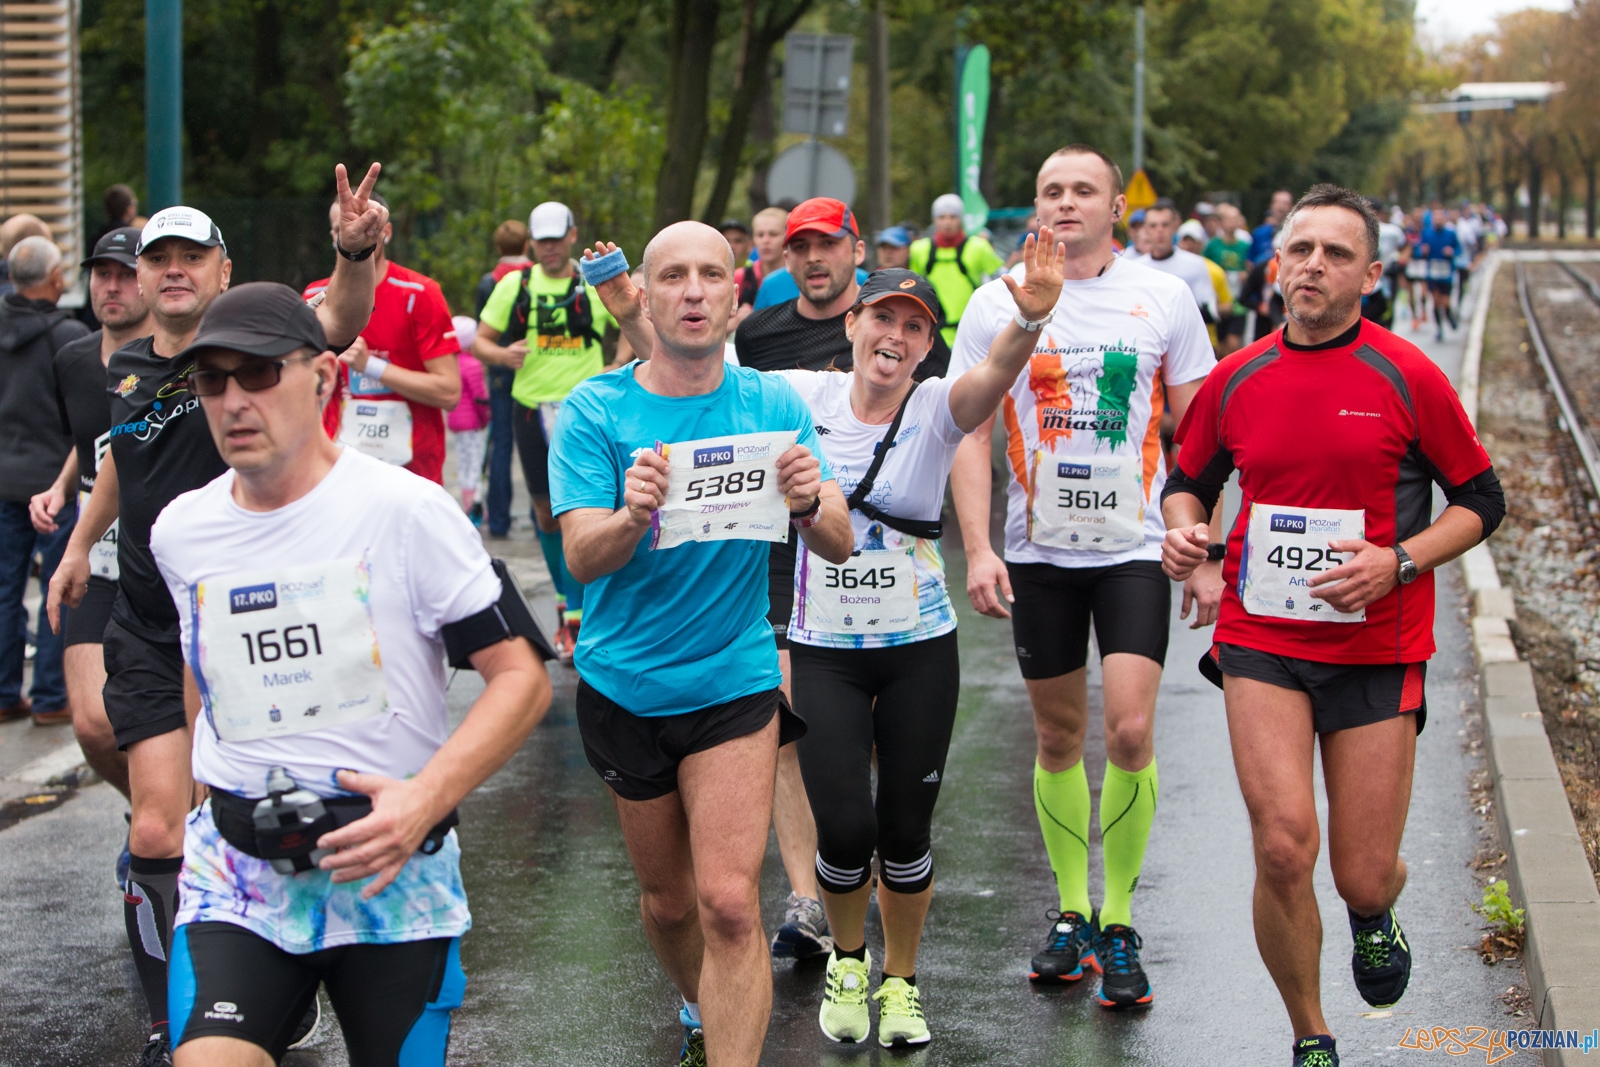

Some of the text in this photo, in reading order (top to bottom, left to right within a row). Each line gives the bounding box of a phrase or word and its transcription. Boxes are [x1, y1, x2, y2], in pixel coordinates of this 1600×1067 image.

[1099, 344, 1137, 353] Kasta
[1042, 415, 1125, 431] Miasta
[357, 423, 389, 438] 788
[737, 451, 770, 461] maraton
[685, 469, 766, 501] 5389
[1058, 488, 1118, 509] 3614
[700, 501, 751, 514] Zbigniew
[1069, 513, 1106, 523] Konrad
[724, 522, 738, 530] 4F
[1267, 545, 1343, 571] 4925
[825, 566, 896, 589] 3645
[840, 594, 881, 604] Bożena
[1309, 604, 1323, 612] 4F
[867, 618, 880, 626] 4F
[241, 623, 322, 665] 1661
[263, 669, 314, 688] Marek
